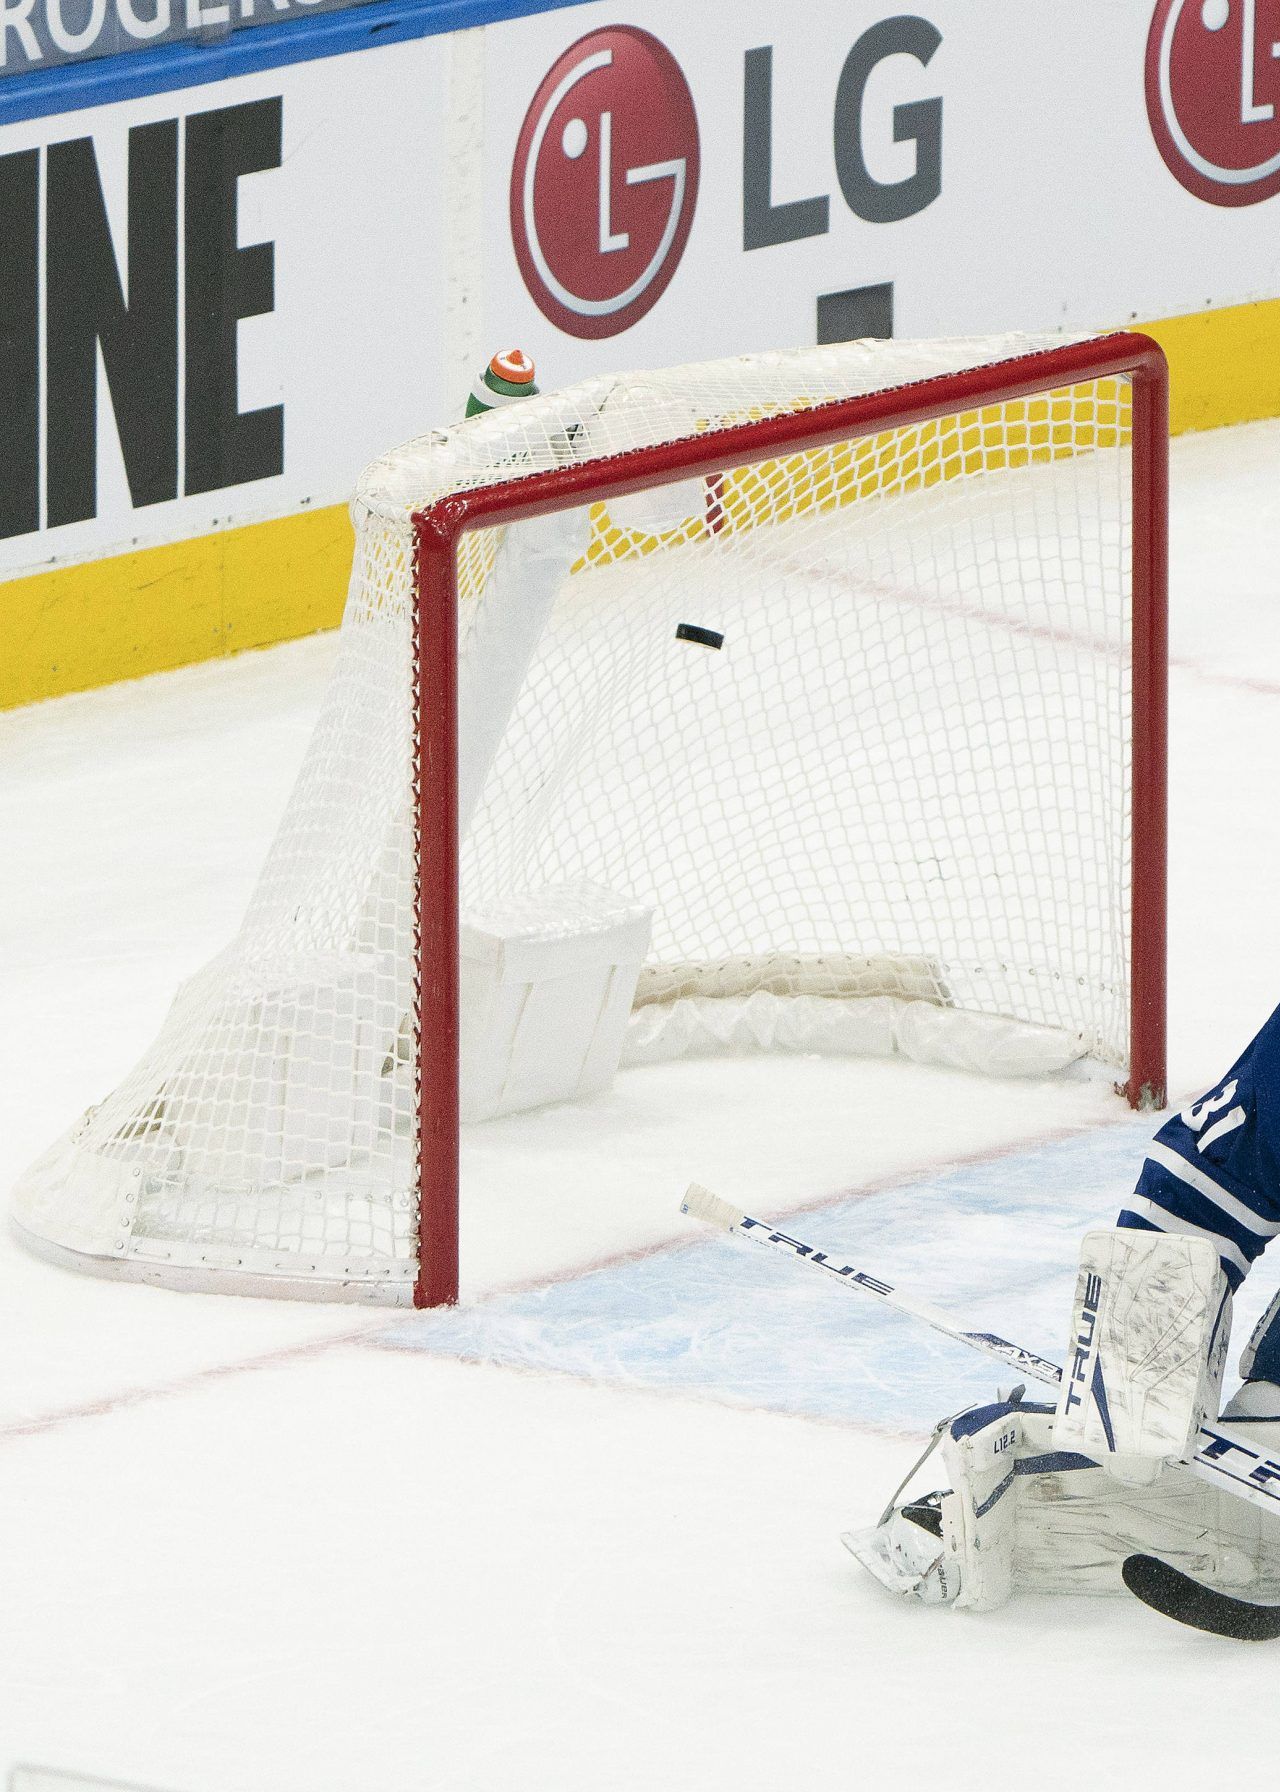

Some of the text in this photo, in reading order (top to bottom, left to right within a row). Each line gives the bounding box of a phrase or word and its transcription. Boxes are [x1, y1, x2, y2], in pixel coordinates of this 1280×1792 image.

[743, 15, 944, 252] LG
[740, 1215, 896, 1297] TRUE
[1065, 1272, 1102, 1416] TRUE
[994, 1429, 1016, 1454] L12.2
